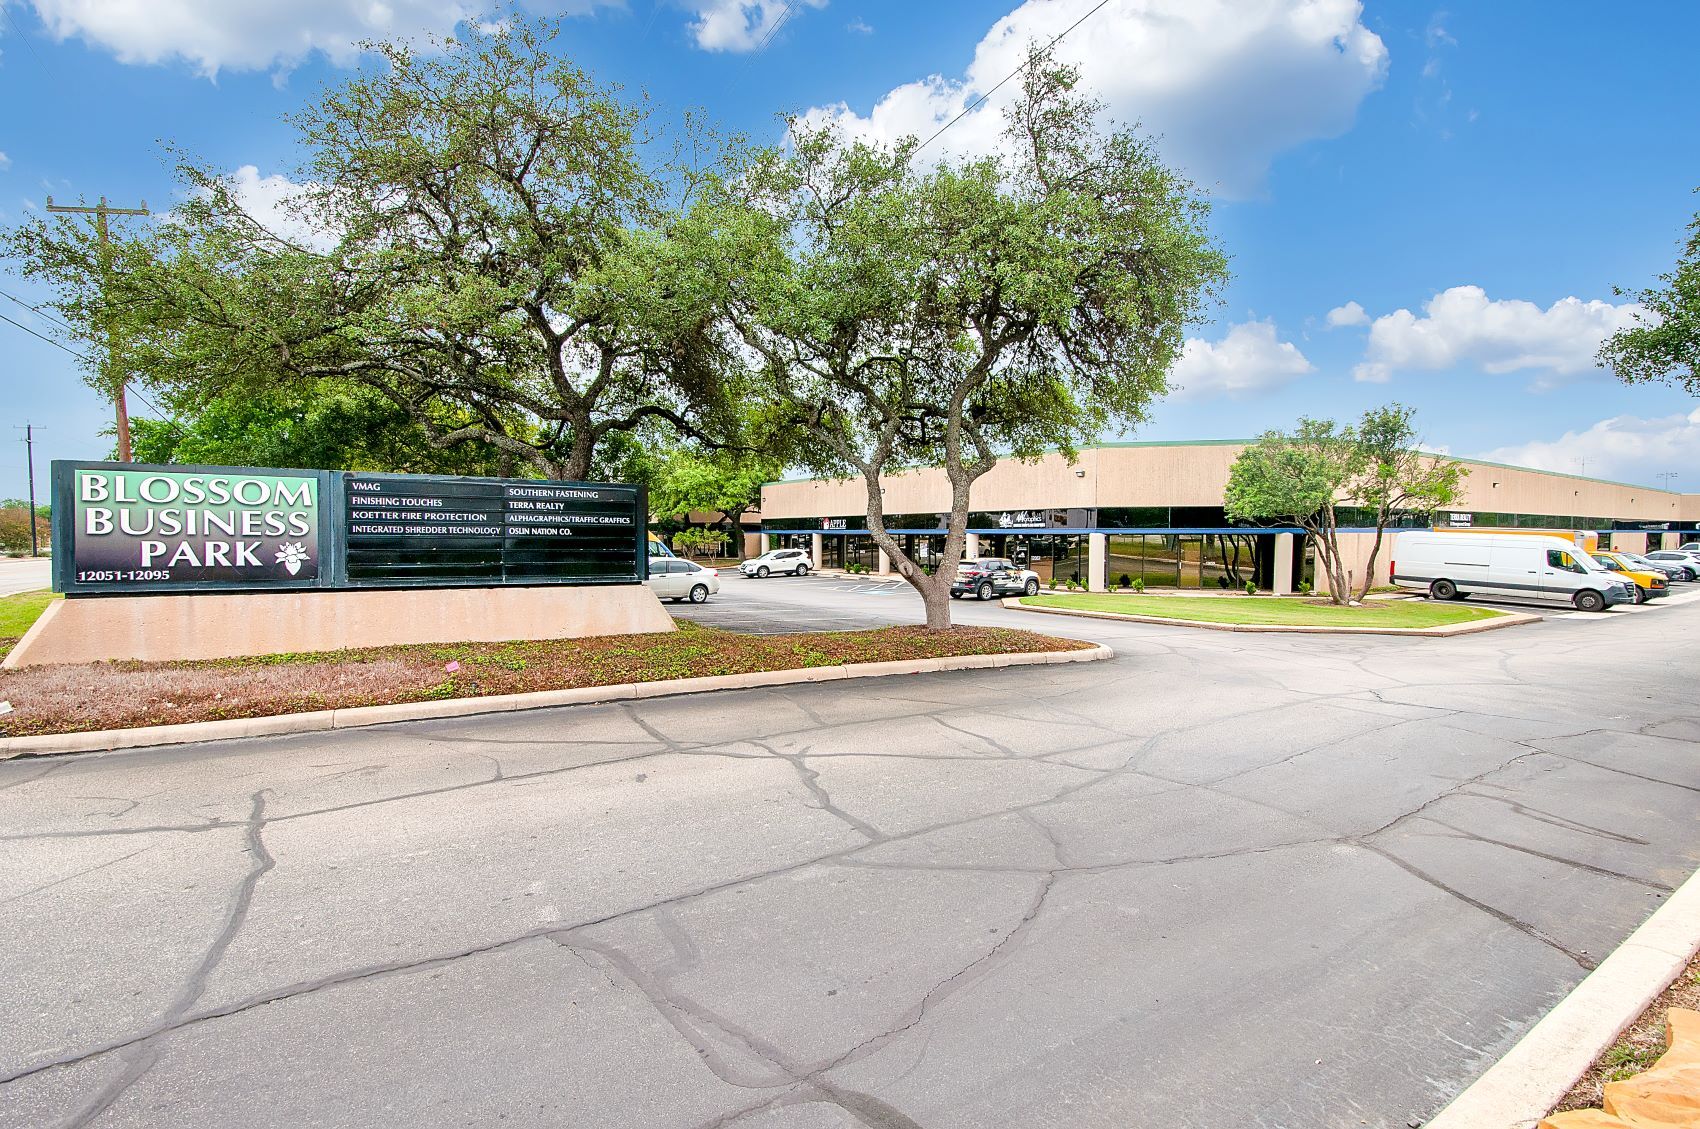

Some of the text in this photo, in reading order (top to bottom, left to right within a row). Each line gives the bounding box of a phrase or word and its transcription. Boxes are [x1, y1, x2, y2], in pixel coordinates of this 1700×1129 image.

[81, 473, 313, 507] BLOSSOM
[352, 482, 381, 491] VMAG
[509, 488, 599, 499] SOUTHERN FASTENING
[352, 496, 443, 507] FINISHING TOUCHES
[509, 501, 565, 510] TERRA REALTY
[352, 511, 487, 521] KOETTER FIRE PROTECTION
[599, 516, 631, 524] GRAFFICS
[85, 507, 311, 537] BUSINESS
[352, 525, 501, 535] INTEGRATED SHREDDER TECHNOLOGY
[509, 527, 573, 536] OSLIN NATION CO.
[140, 540, 263, 567] PARK
[78, 570, 170, 581] 12051-12095
